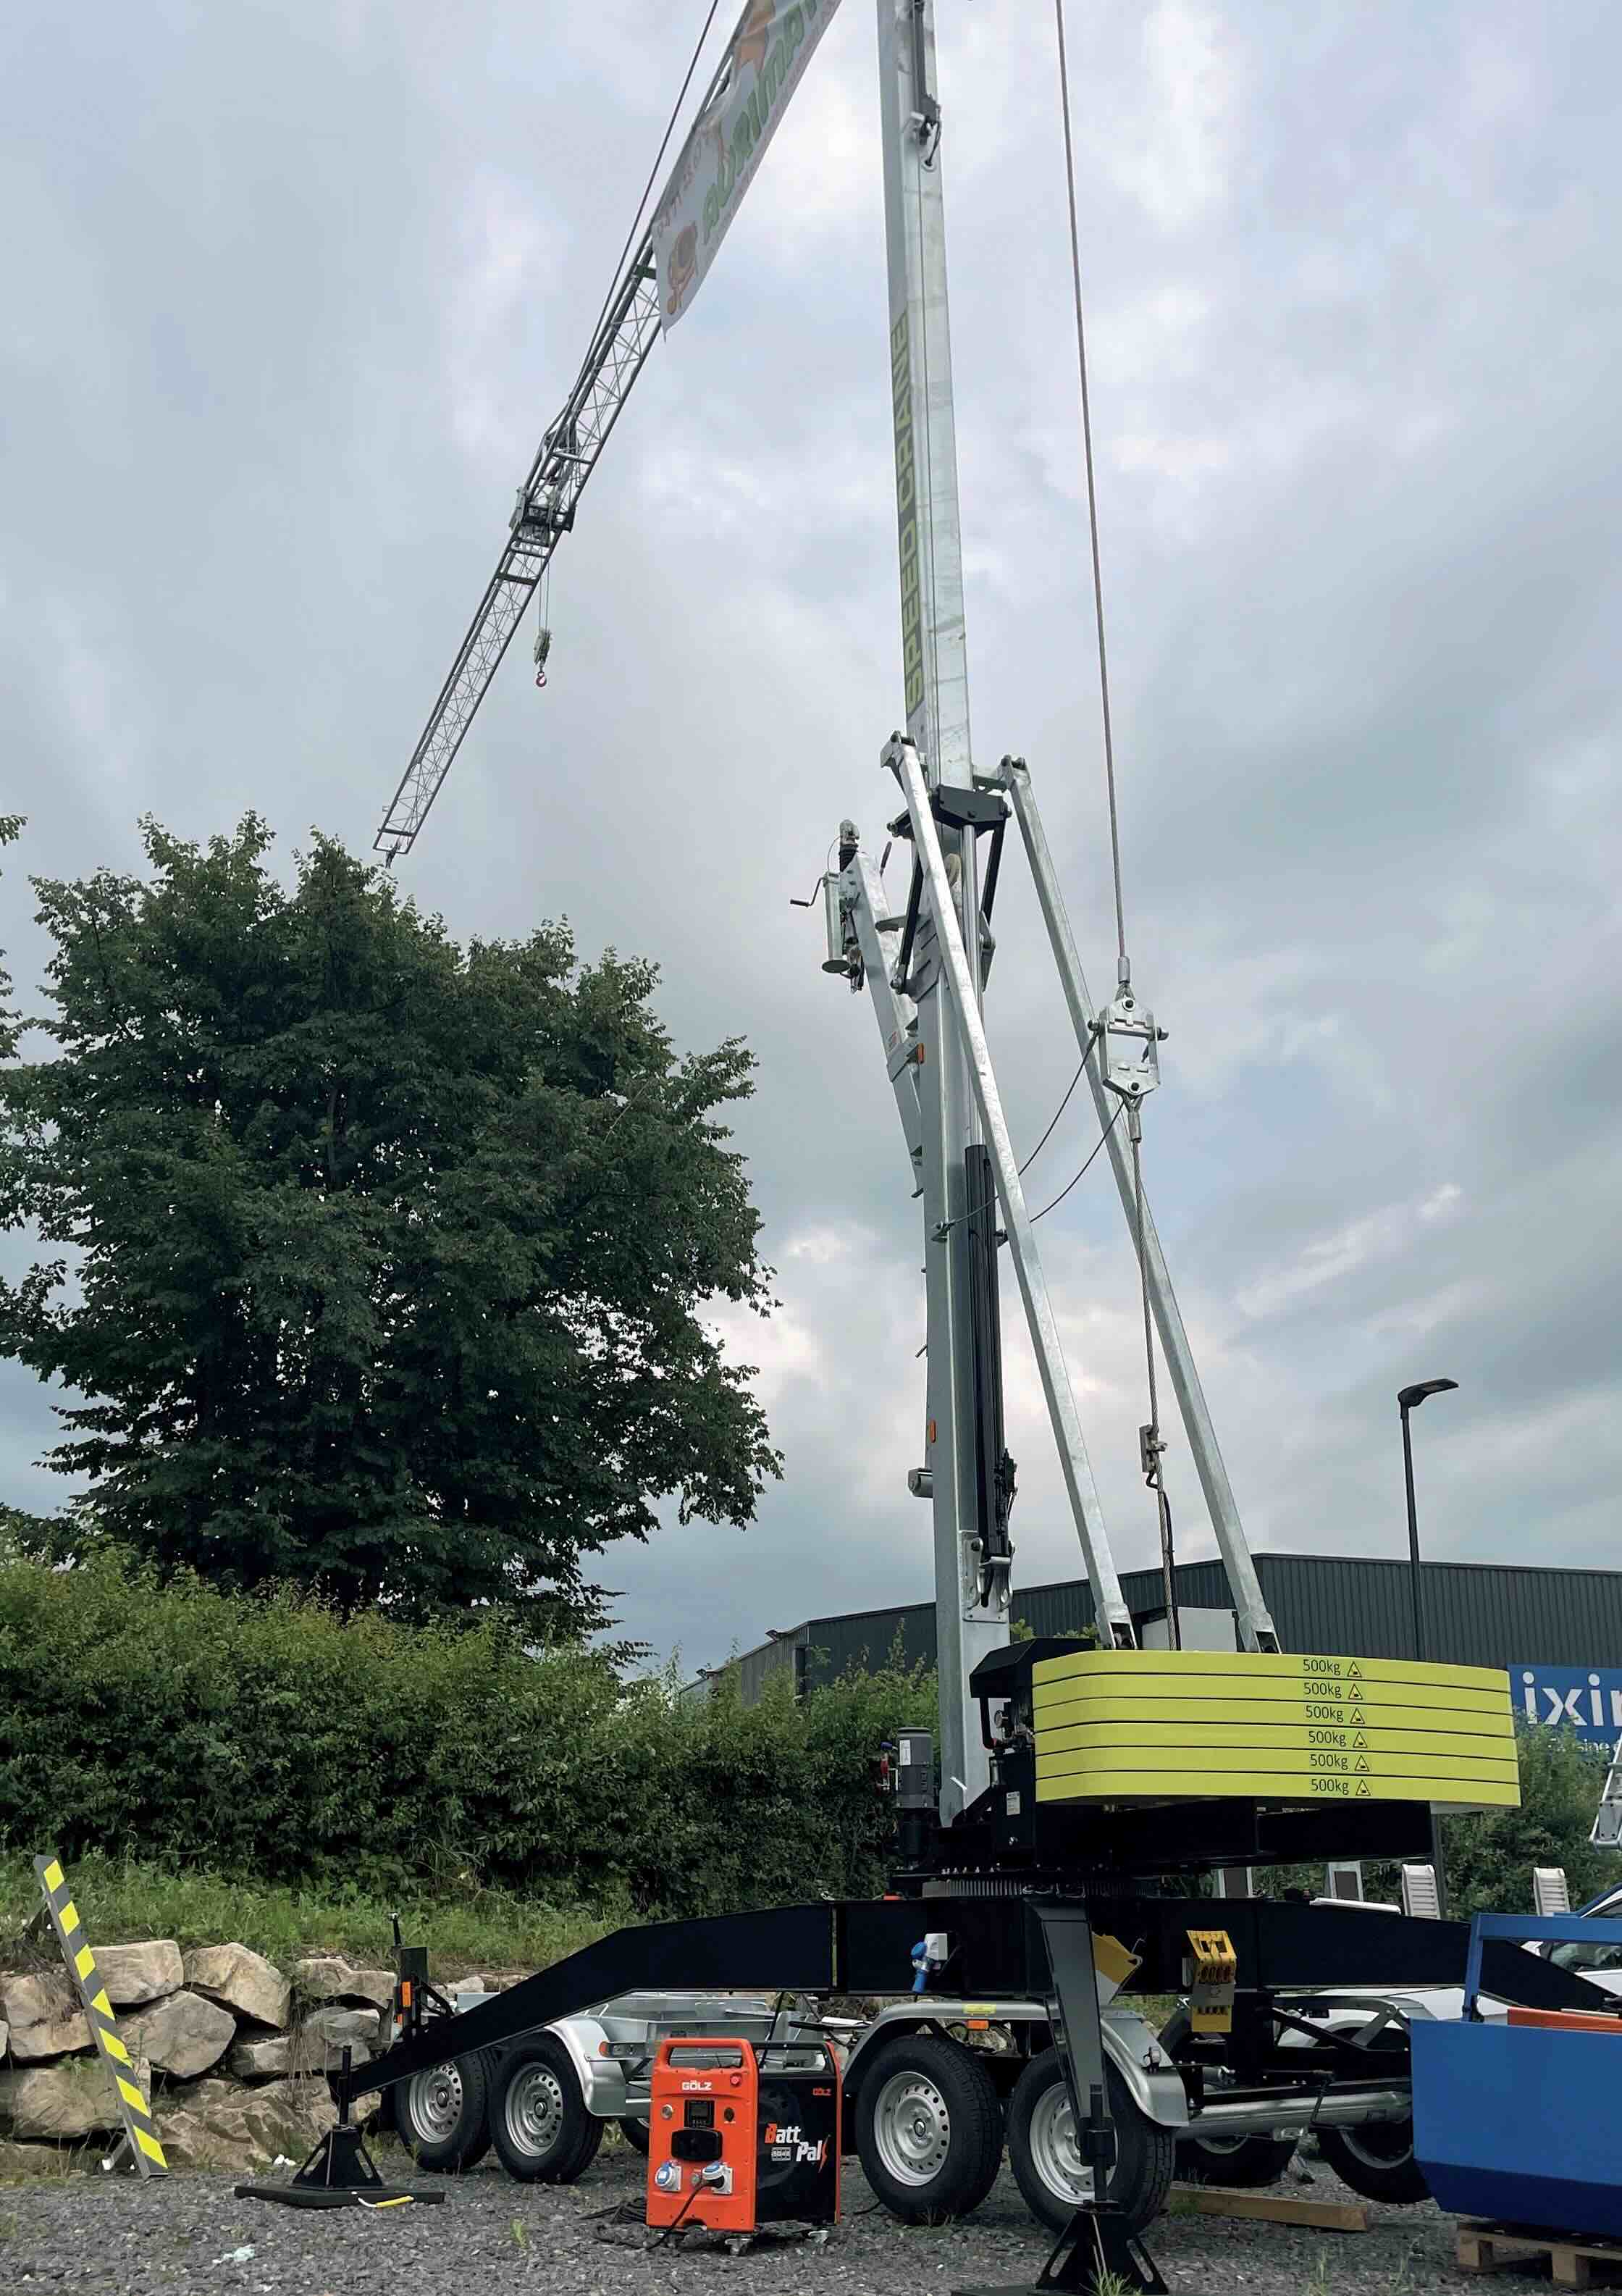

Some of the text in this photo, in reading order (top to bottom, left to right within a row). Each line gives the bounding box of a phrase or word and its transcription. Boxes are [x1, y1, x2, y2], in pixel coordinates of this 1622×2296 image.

[891, 314, 923, 713] SPEED CRANE
[1303, 1659, 1341, 1676] 500kg
[1303, 1682, 1342, 1698] 500kg
[1306, 1705, 1344, 1722] 500kg
[1308, 1730, 1346, 1747] 500kg
[1310, 1754, 1348, 1770] 500kg
[1311, 1778, 1349, 1796] 500kg
[681, 2079, 712, 2091] GÖLZ
[765, 2123, 801, 2144] Batt
[796, 2140, 823, 2162] Pal
